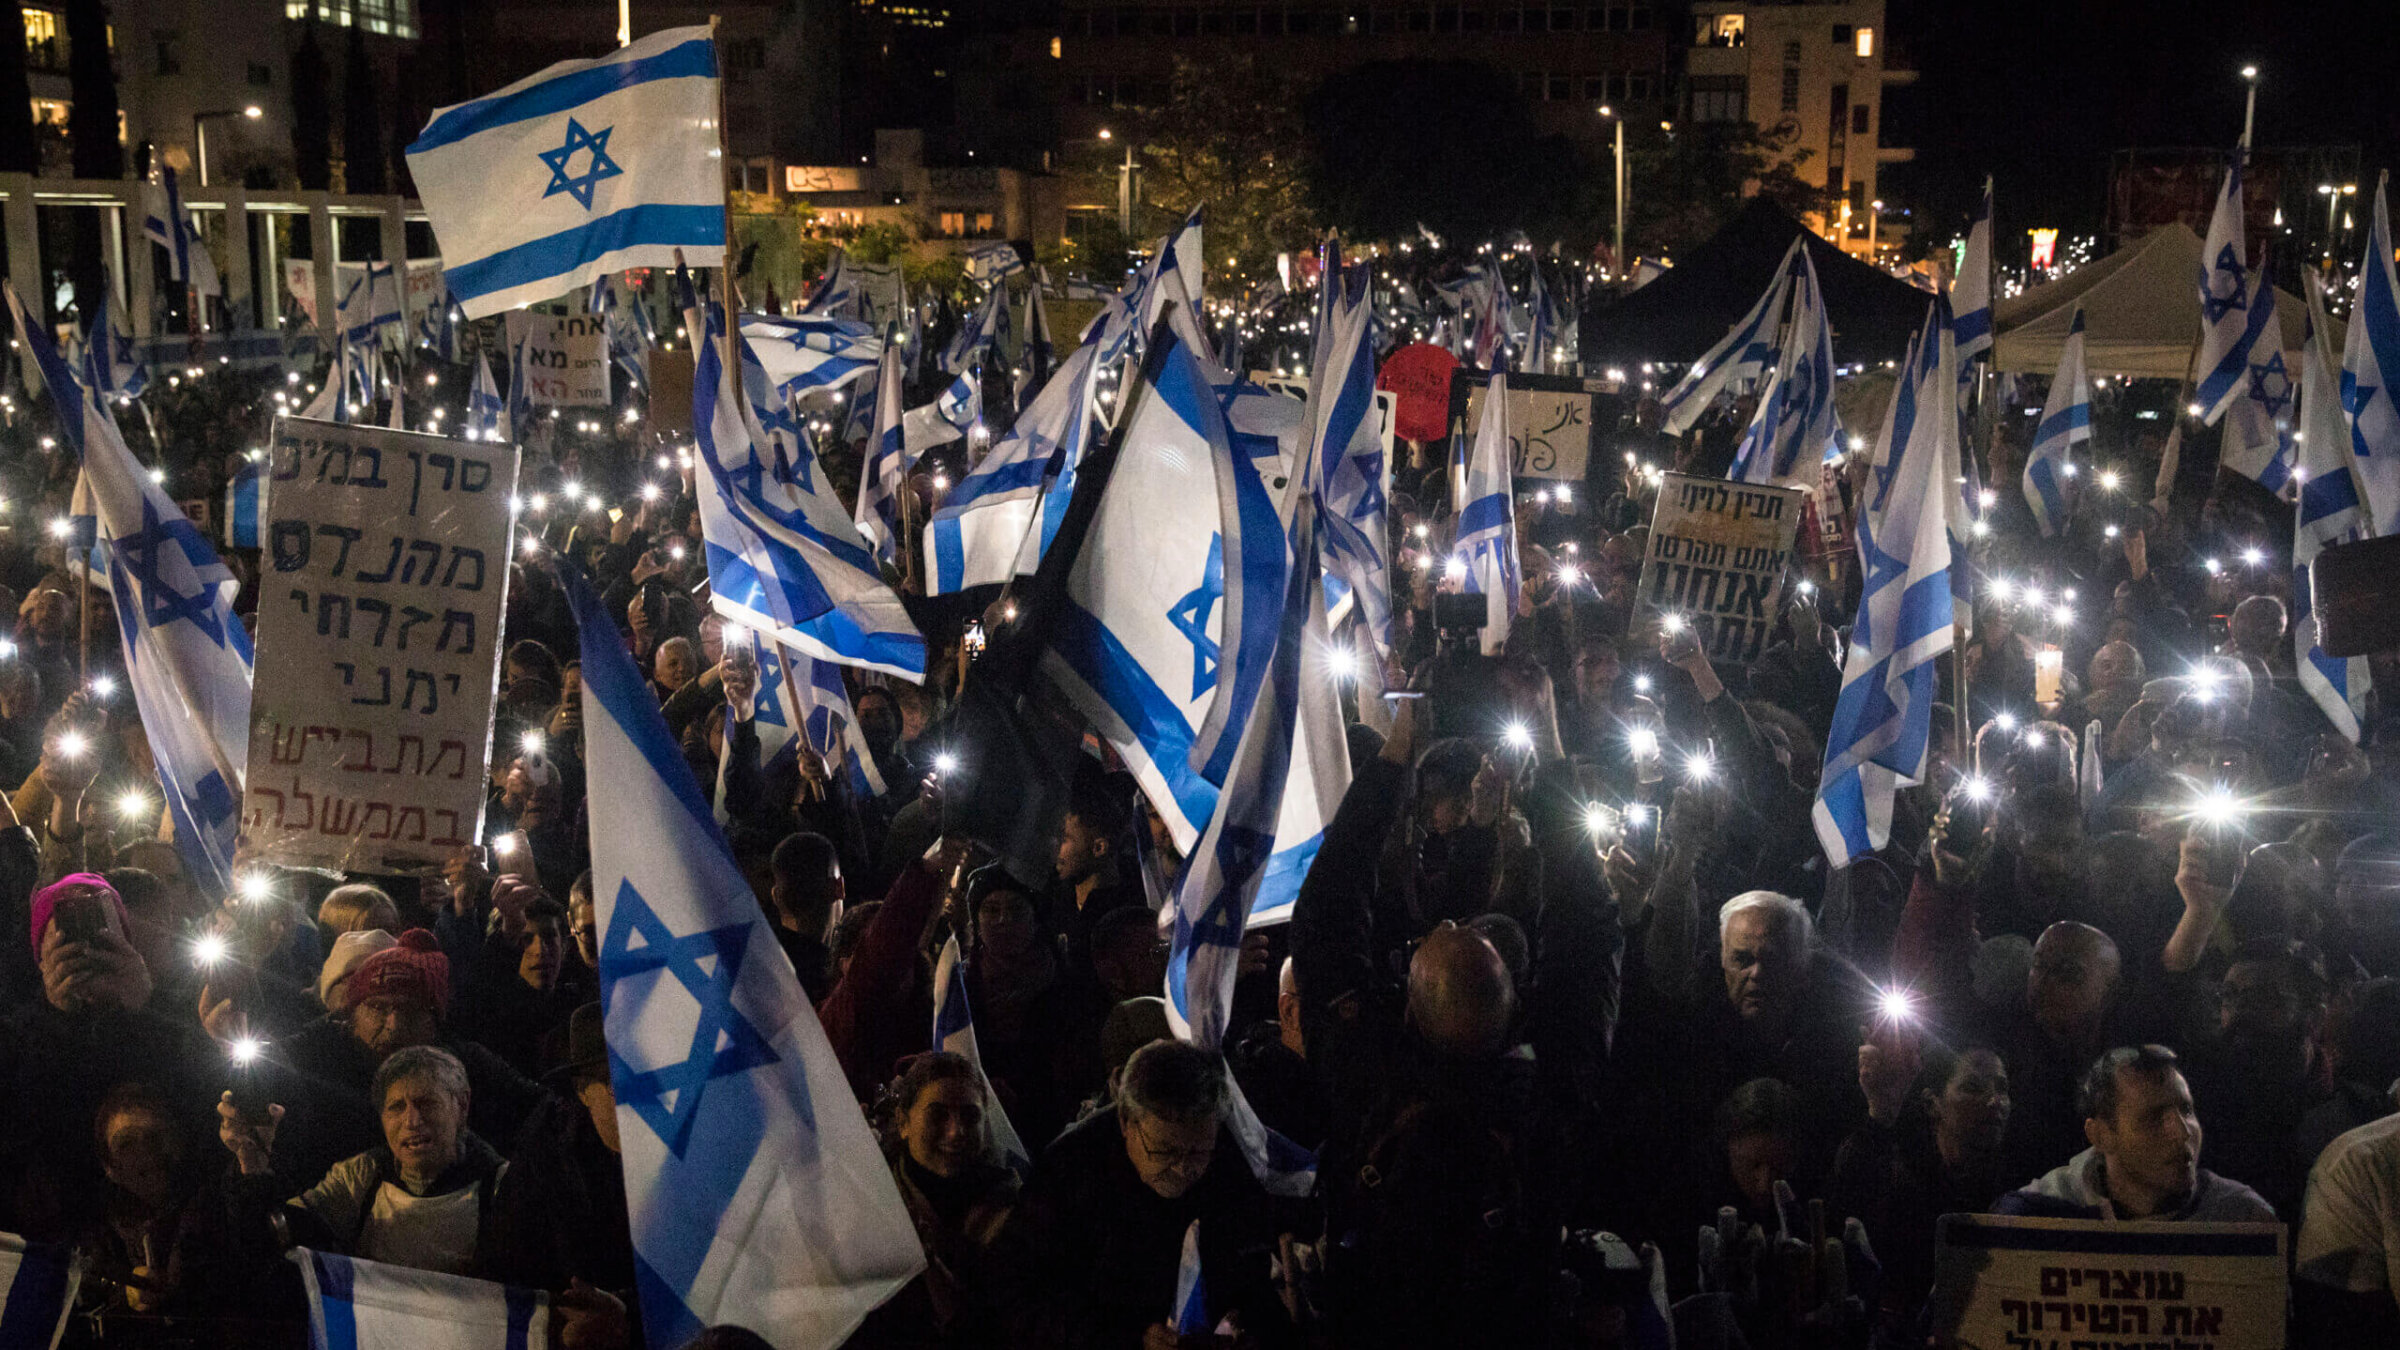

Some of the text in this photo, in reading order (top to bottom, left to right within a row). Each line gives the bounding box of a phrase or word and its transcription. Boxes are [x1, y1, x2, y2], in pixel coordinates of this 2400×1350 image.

[1542, 401, 1583, 434] אני
[409, 451, 492, 516] סרן
[271, 520, 485, 591] מהנדס
[1734, 547, 1785, 572] אתם
[1652, 561, 1773, 618] אנחנו
[290, 589, 475, 654] מזרחי
[334, 662, 460, 715] ימני
[271, 723, 467, 779] מתבייש
[2041, 1266, 2185, 1300] עוצרים
[2001, 1300, 2223, 1336] את הטירוף
